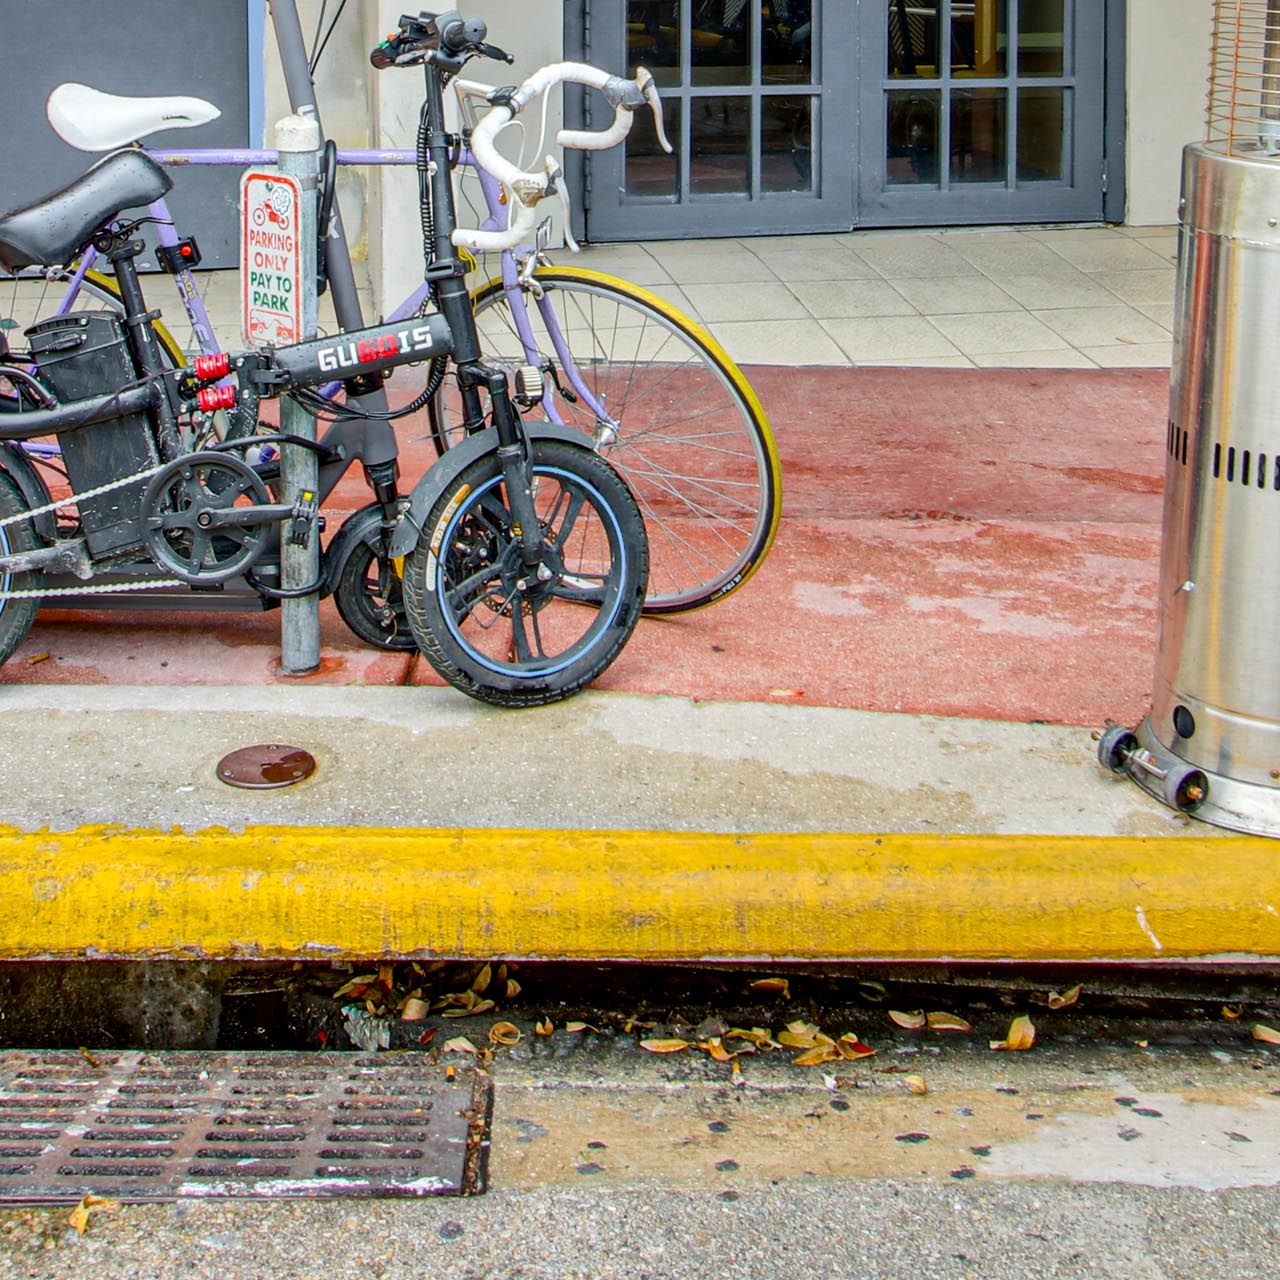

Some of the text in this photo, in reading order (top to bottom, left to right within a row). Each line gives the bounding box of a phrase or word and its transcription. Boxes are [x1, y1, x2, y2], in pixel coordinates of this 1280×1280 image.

[250, 228, 292, 253] PARKING
[254, 251, 289, 273] ONLY
[251, 271, 292, 294] PAY TO
[253, 290, 289, 313] PARK
